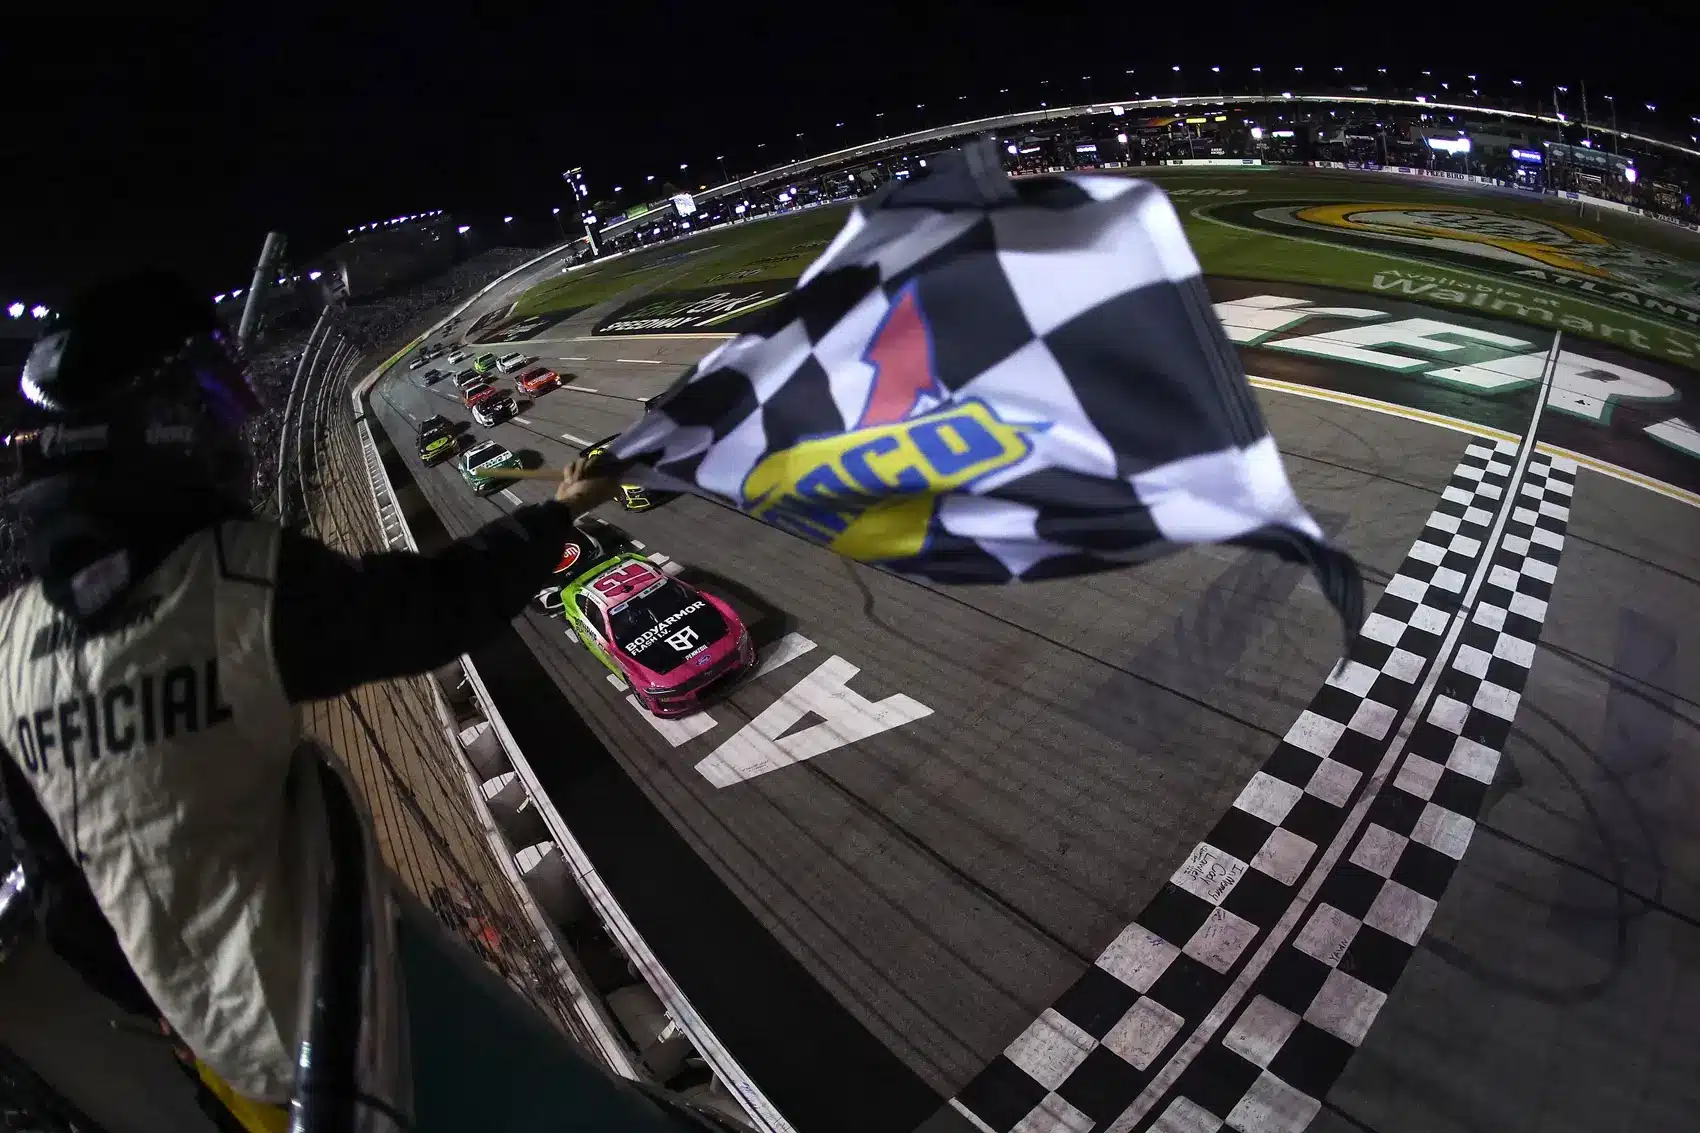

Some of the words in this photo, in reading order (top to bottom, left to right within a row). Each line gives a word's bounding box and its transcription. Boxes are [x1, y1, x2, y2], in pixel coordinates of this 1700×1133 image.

[1427, 170, 1445, 178] FREE
[1446, 172, 1465, 180] BIRD
[1379, 270, 1521, 299] Available
[1533, 296, 1561, 309] at
[600, 316, 700, 332] SPEEDWAY
[1371, 274, 1651, 350] Walmart
[625, 600, 706, 652] BODYARMOR
[630, 636, 658, 656] FLASH
[656, 628, 672, 639] I.V.
[18, 658, 233, 773] OFFICIAL
[1328, 938, 1349, 962] YAWN
